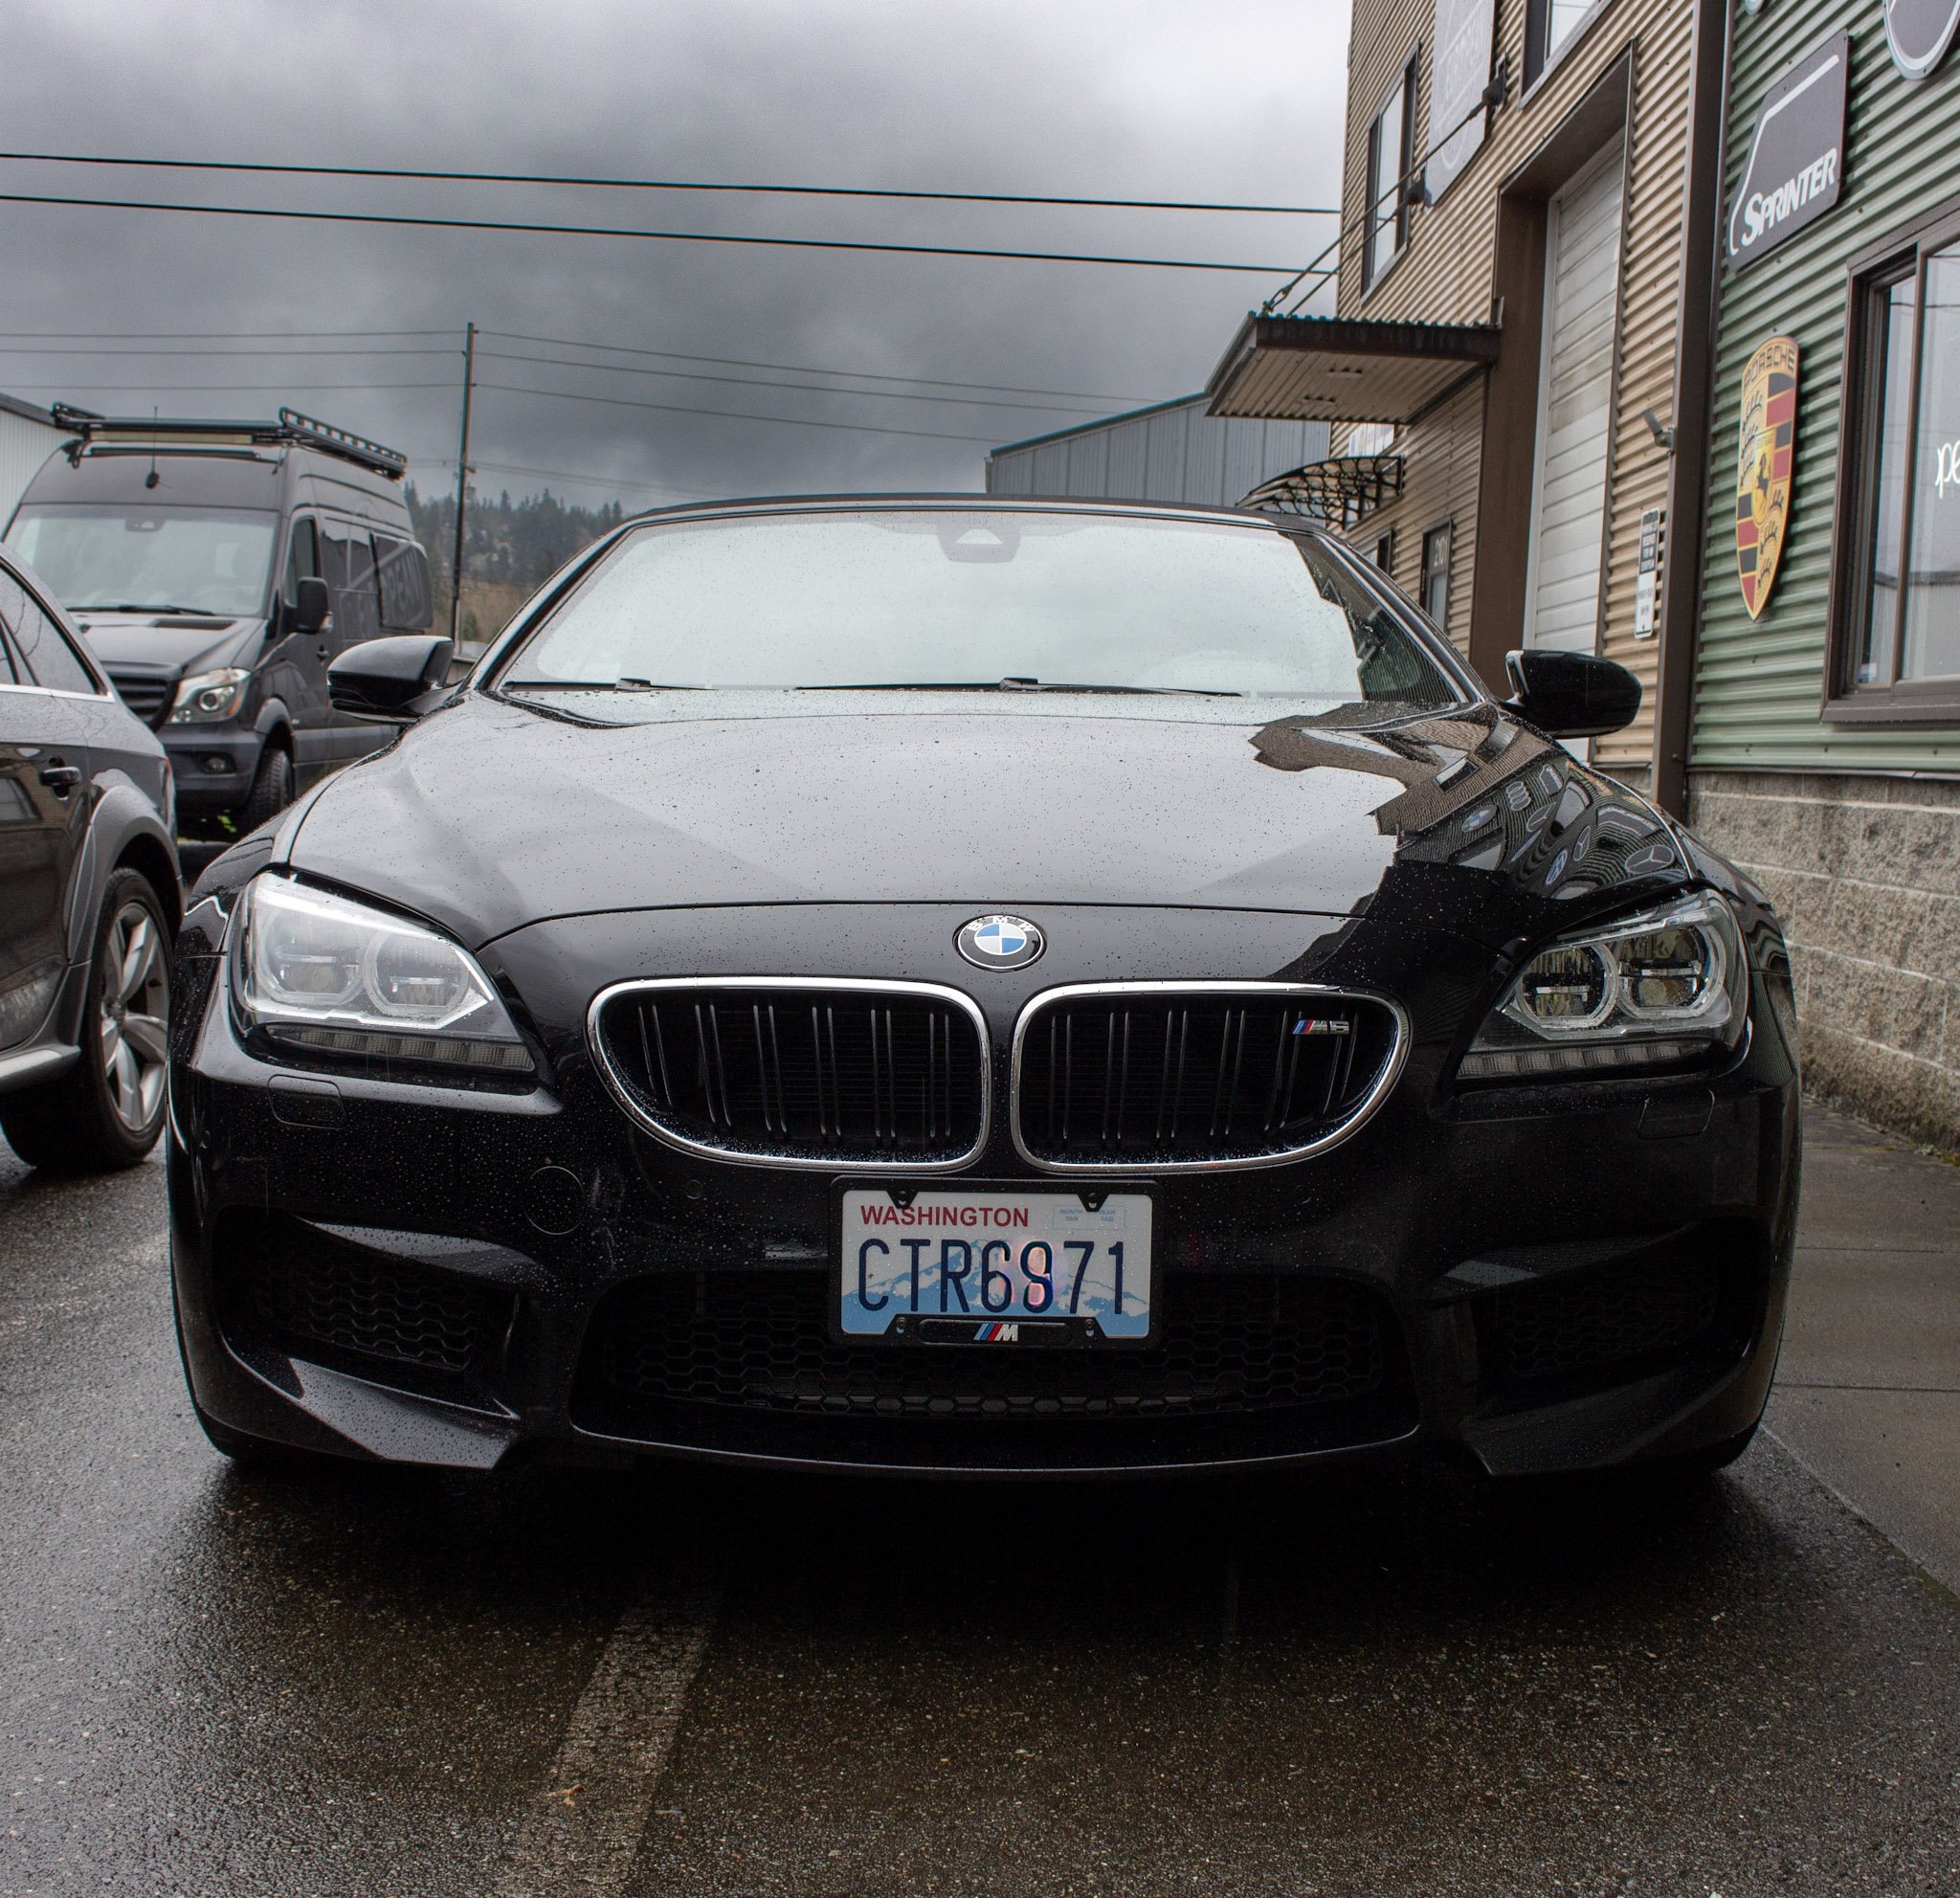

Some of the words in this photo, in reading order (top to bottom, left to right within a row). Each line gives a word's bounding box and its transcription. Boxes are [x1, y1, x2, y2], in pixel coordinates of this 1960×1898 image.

[1742, 147, 1838, 247] SPRINTER
[1744, 345, 1795, 390] PORSCHE
[967, 916, 1036, 932] BMW
[860, 1205, 1029, 1227] WASHINGTON
